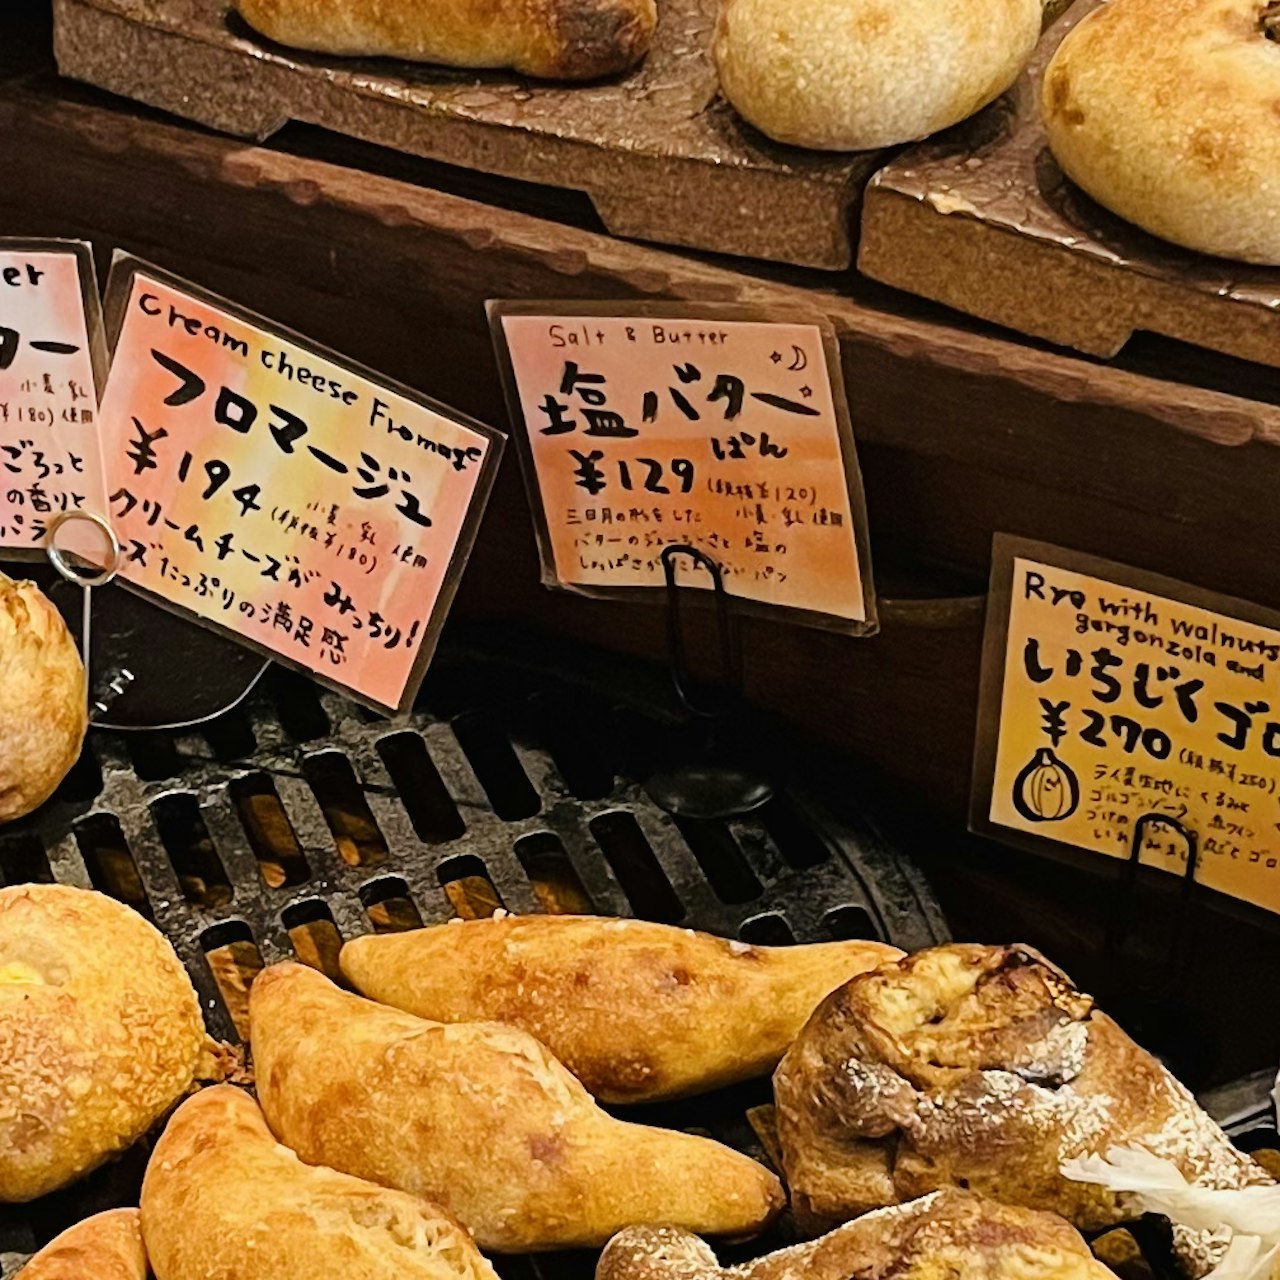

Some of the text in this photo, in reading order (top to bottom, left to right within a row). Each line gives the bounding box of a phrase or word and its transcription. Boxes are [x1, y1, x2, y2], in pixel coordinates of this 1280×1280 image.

[549, 324, 729, 348] Salt & Butter
[138, 291, 483, 473] Cream cheese Fromage
[537, 360, 822, 439] 塩バター
[125, 415, 264, 518] ¥194
[149, 347, 434, 529] フロマージュ
[568, 448, 696, 497] ¥129
[710, 431, 790, 461] ぱん
[107, 487, 422, 650] クリームチーズが みっちり!
[117, 536, 351, 665] ーズたっぷりの満足感
[1024, 571, 1085, 610] Rye
[1098, 596, 1160, 627] with
[1038, 697, 1173, 761] ¥270
